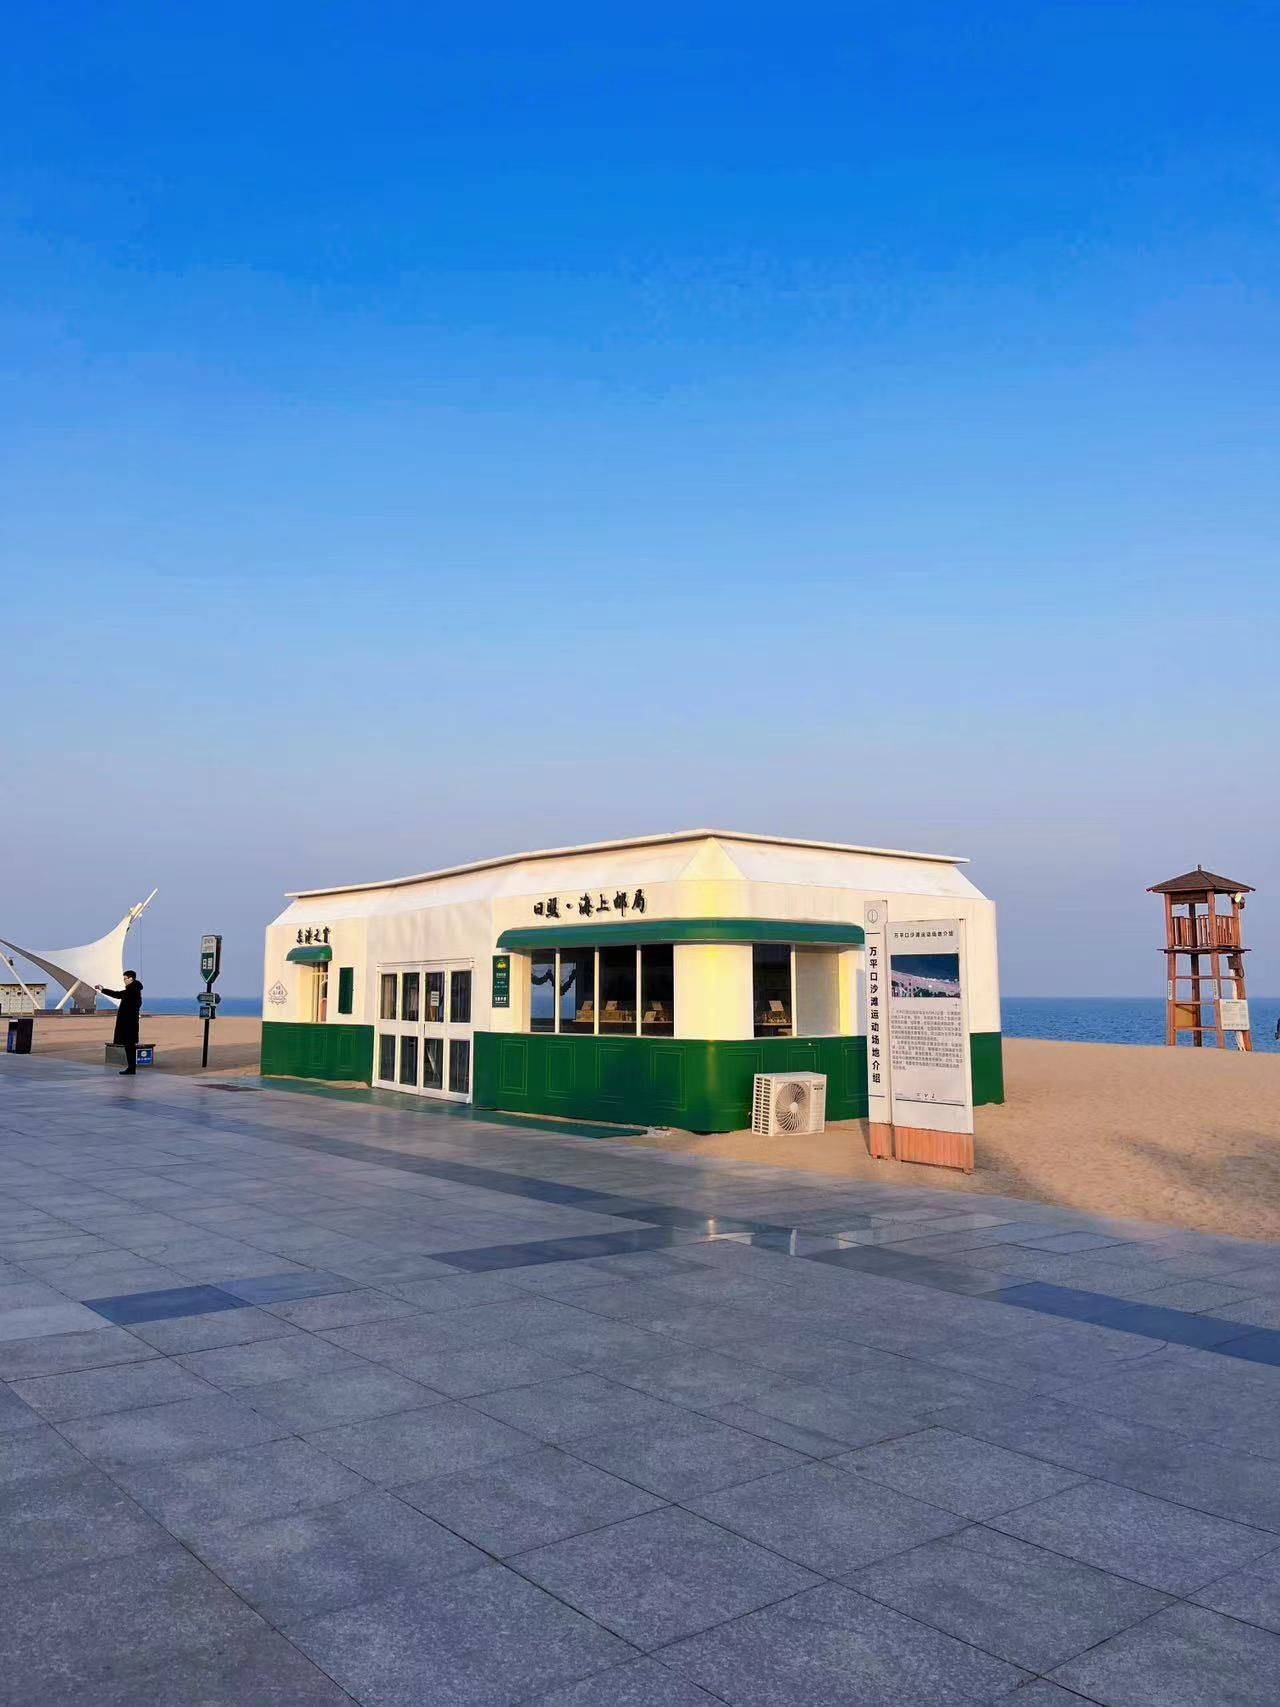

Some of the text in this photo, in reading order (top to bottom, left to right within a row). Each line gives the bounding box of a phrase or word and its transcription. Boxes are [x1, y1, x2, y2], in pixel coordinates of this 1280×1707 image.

[869, 946, 881, 1083] 万平口沙滩运动场地介绍
